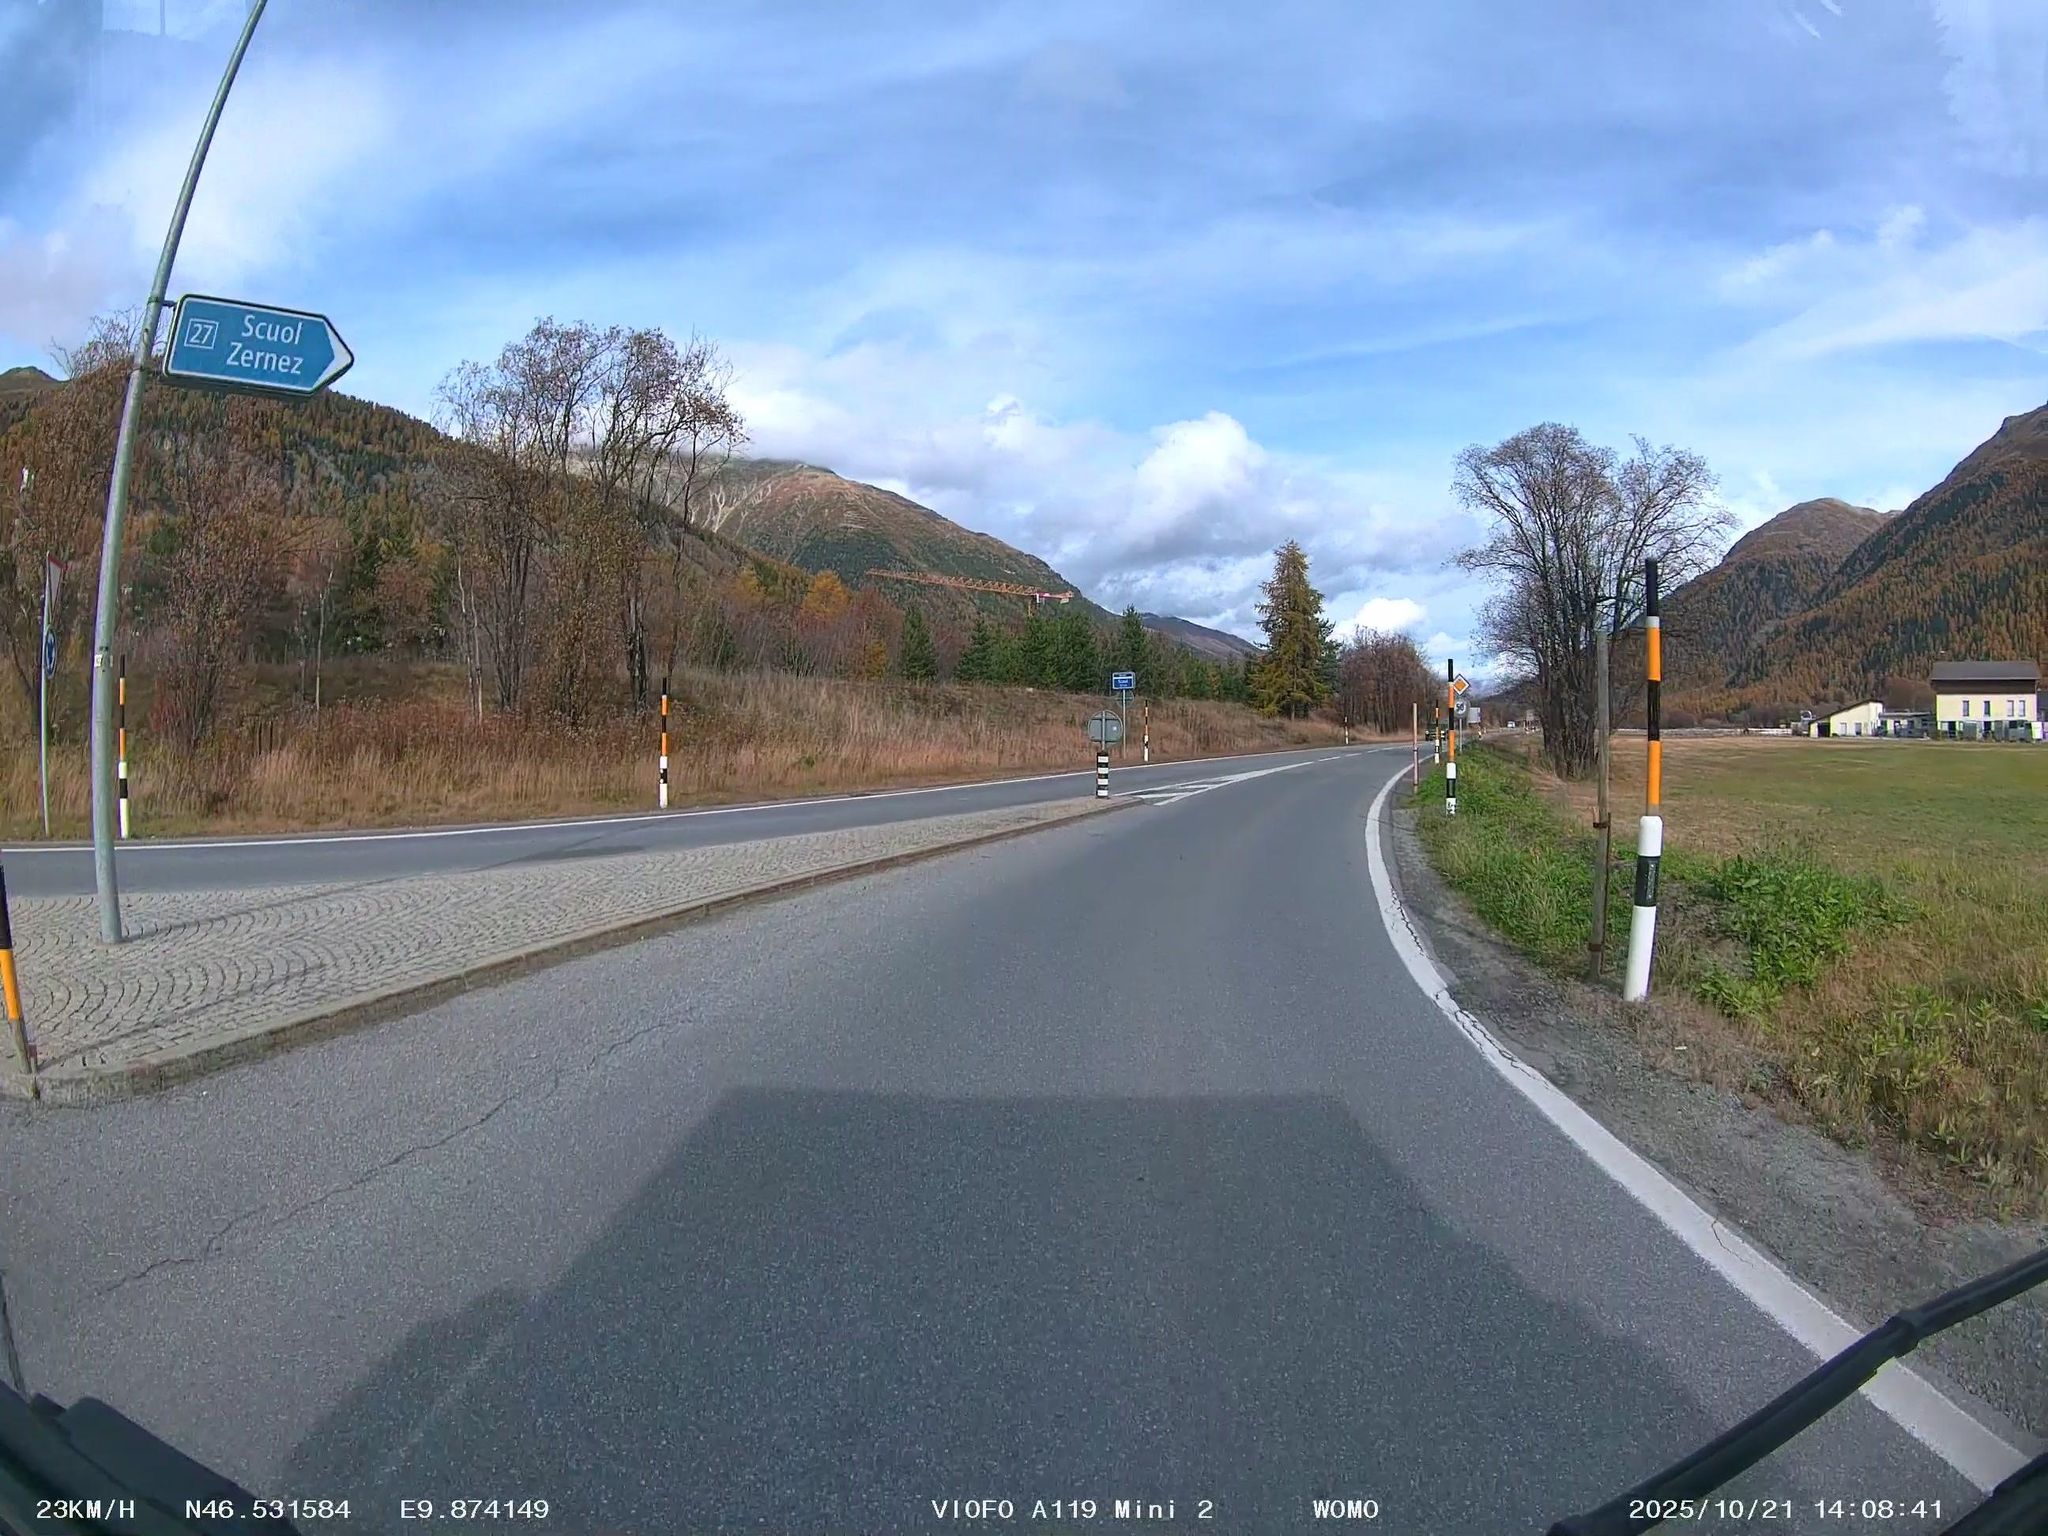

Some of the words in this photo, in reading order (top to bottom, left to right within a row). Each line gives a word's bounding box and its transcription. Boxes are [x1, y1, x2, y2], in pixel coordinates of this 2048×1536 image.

[189, 323, 214, 345] 27
[241, 314, 303, 345] Scuol
[226, 342, 304, 375] Zernez
